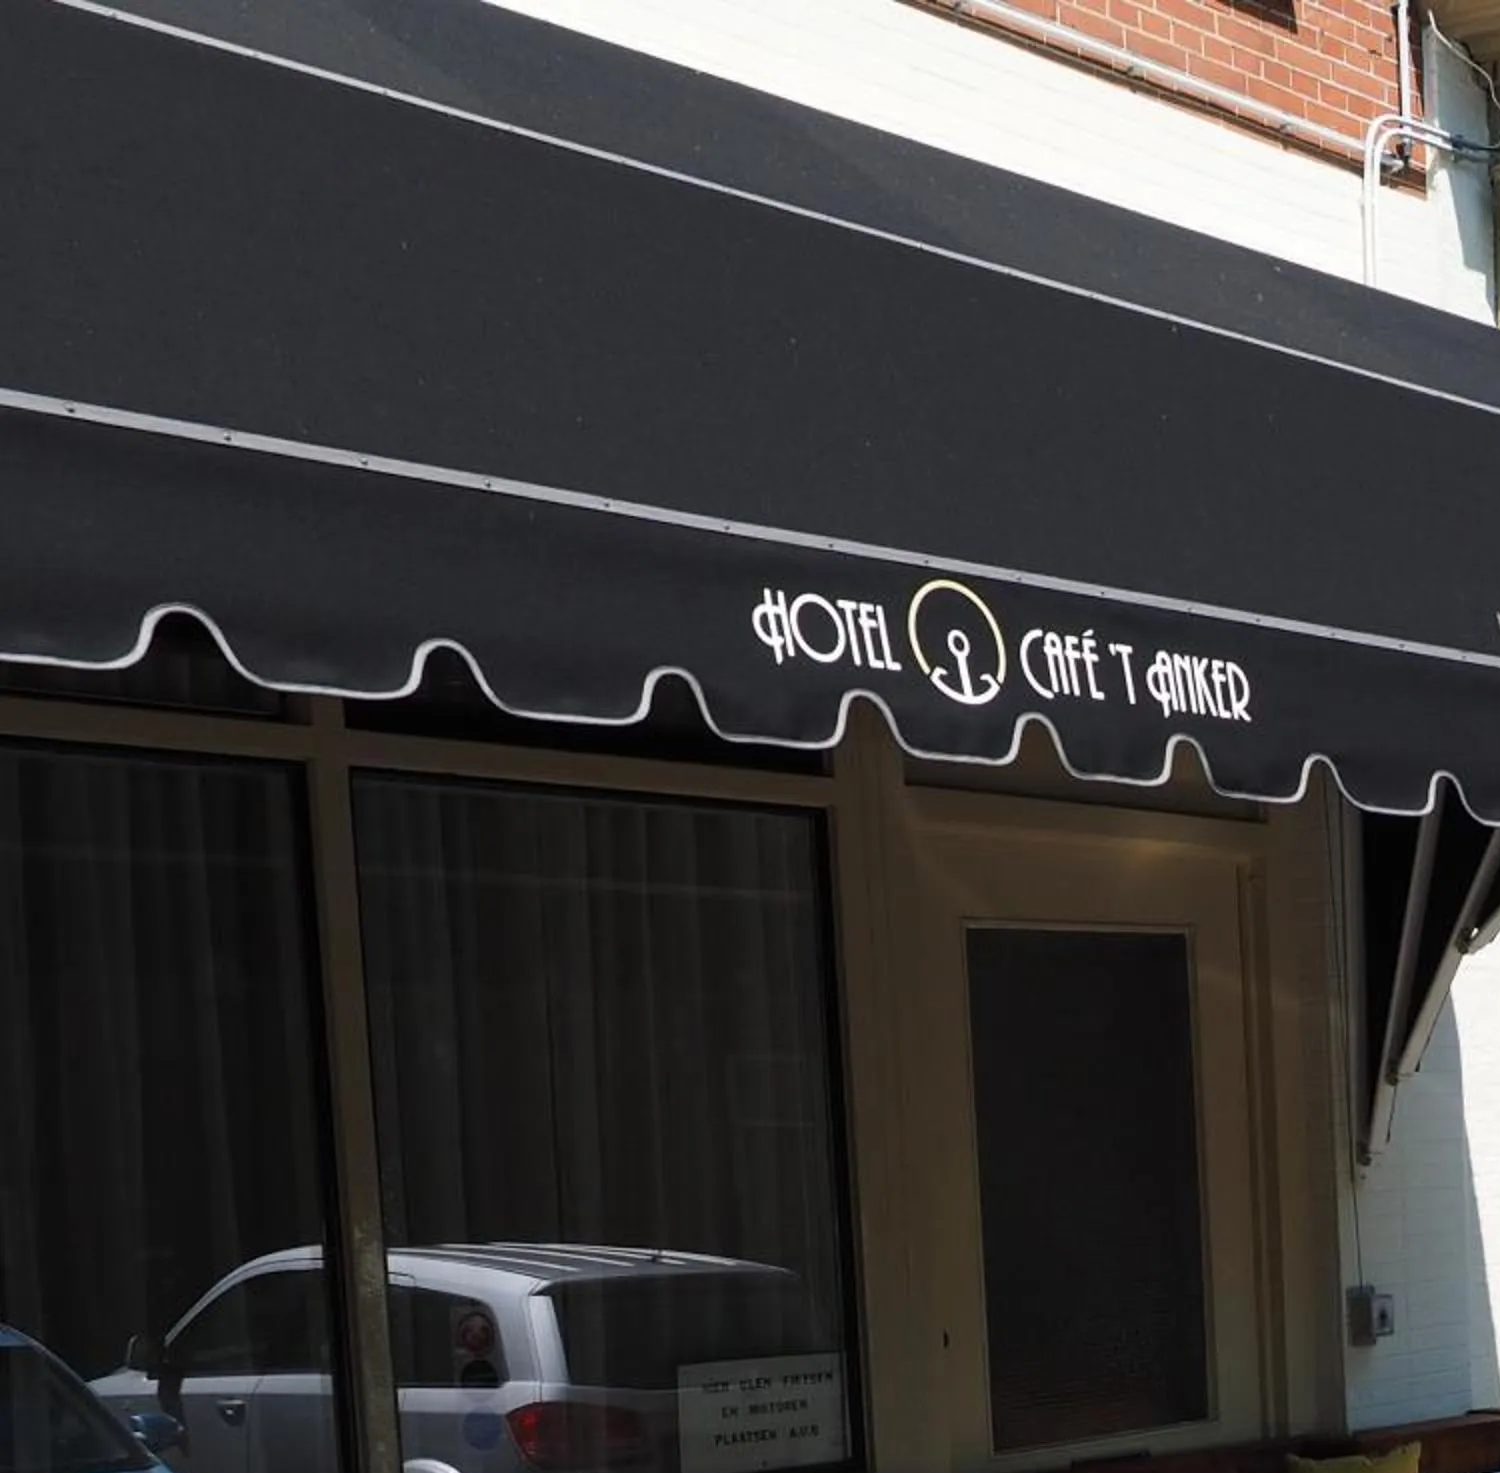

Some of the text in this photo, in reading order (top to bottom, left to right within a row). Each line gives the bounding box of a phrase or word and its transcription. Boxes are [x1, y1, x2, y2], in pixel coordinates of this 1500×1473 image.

[752, 588, 902, 671] HOTEL
[1020, 628, 1105, 701] CAFÉ
[1146, 650, 1252, 723] ANKER
